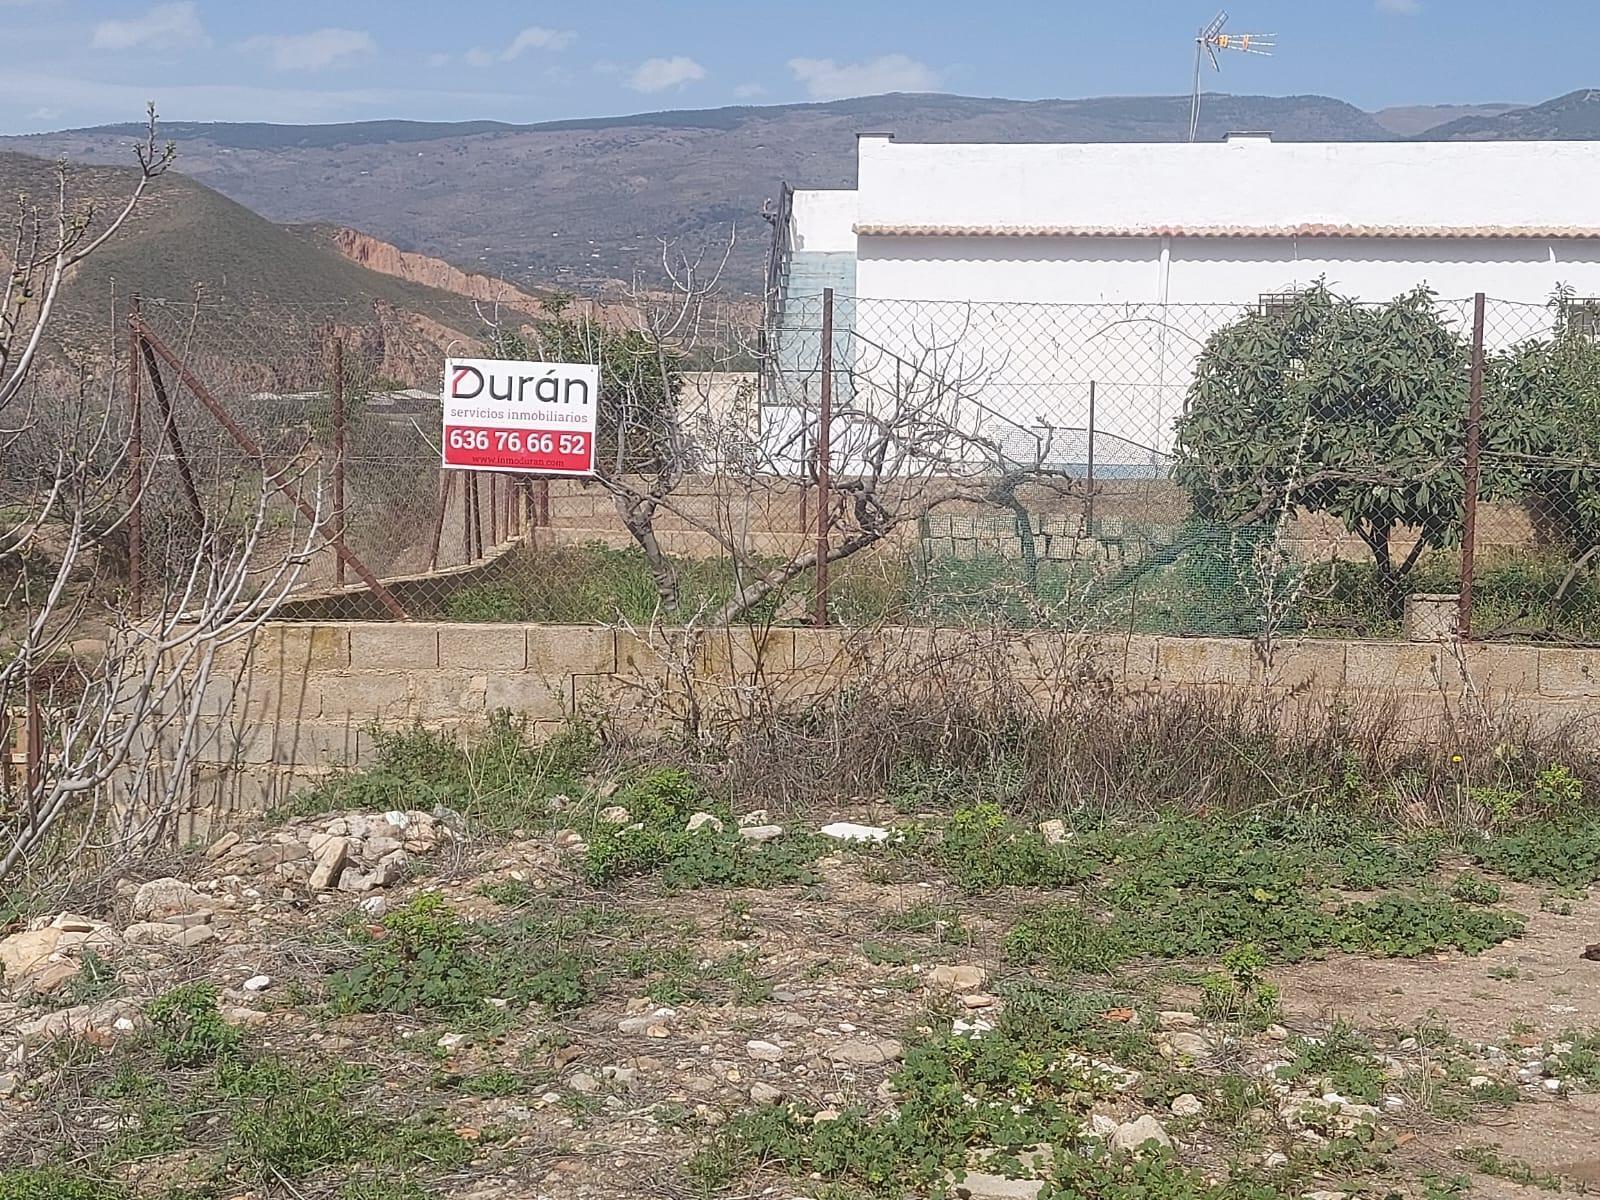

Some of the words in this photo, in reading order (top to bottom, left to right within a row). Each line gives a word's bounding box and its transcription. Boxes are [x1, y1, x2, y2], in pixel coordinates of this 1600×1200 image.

[451, 365, 588, 404] Durán
[450, 407, 504, 419] servicios
[507, 410, 588, 423] inmobiliarios
[450, 429, 489, 450] 636
[526, 433, 554, 454] 66
[558, 434, 585, 455] 52
[472, 455, 565, 467] www.inmoduran.com
